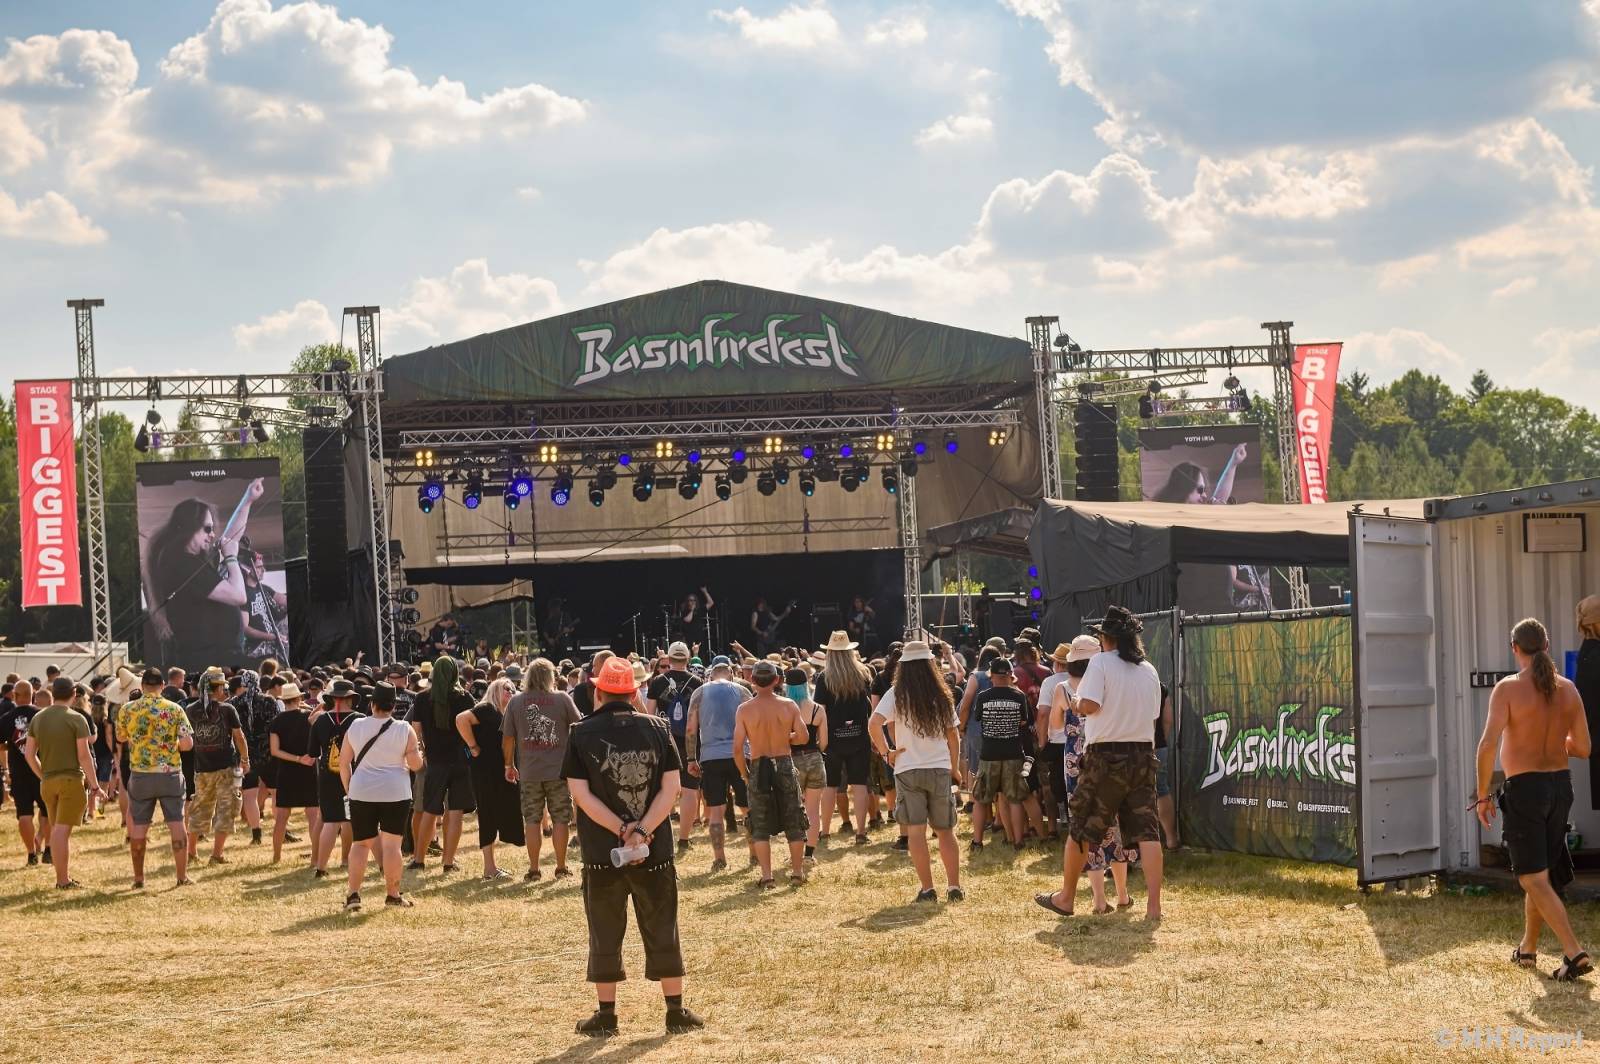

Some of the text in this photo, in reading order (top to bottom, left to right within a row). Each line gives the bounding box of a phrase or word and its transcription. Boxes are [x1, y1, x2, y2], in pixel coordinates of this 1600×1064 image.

[573, 315, 859, 386] Basinfirefest
[30, 386, 57, 395] STAGE
[30, 397, 65, 605] BIGGEST
[1201, 705, 1356, 789] Basinfirefes
